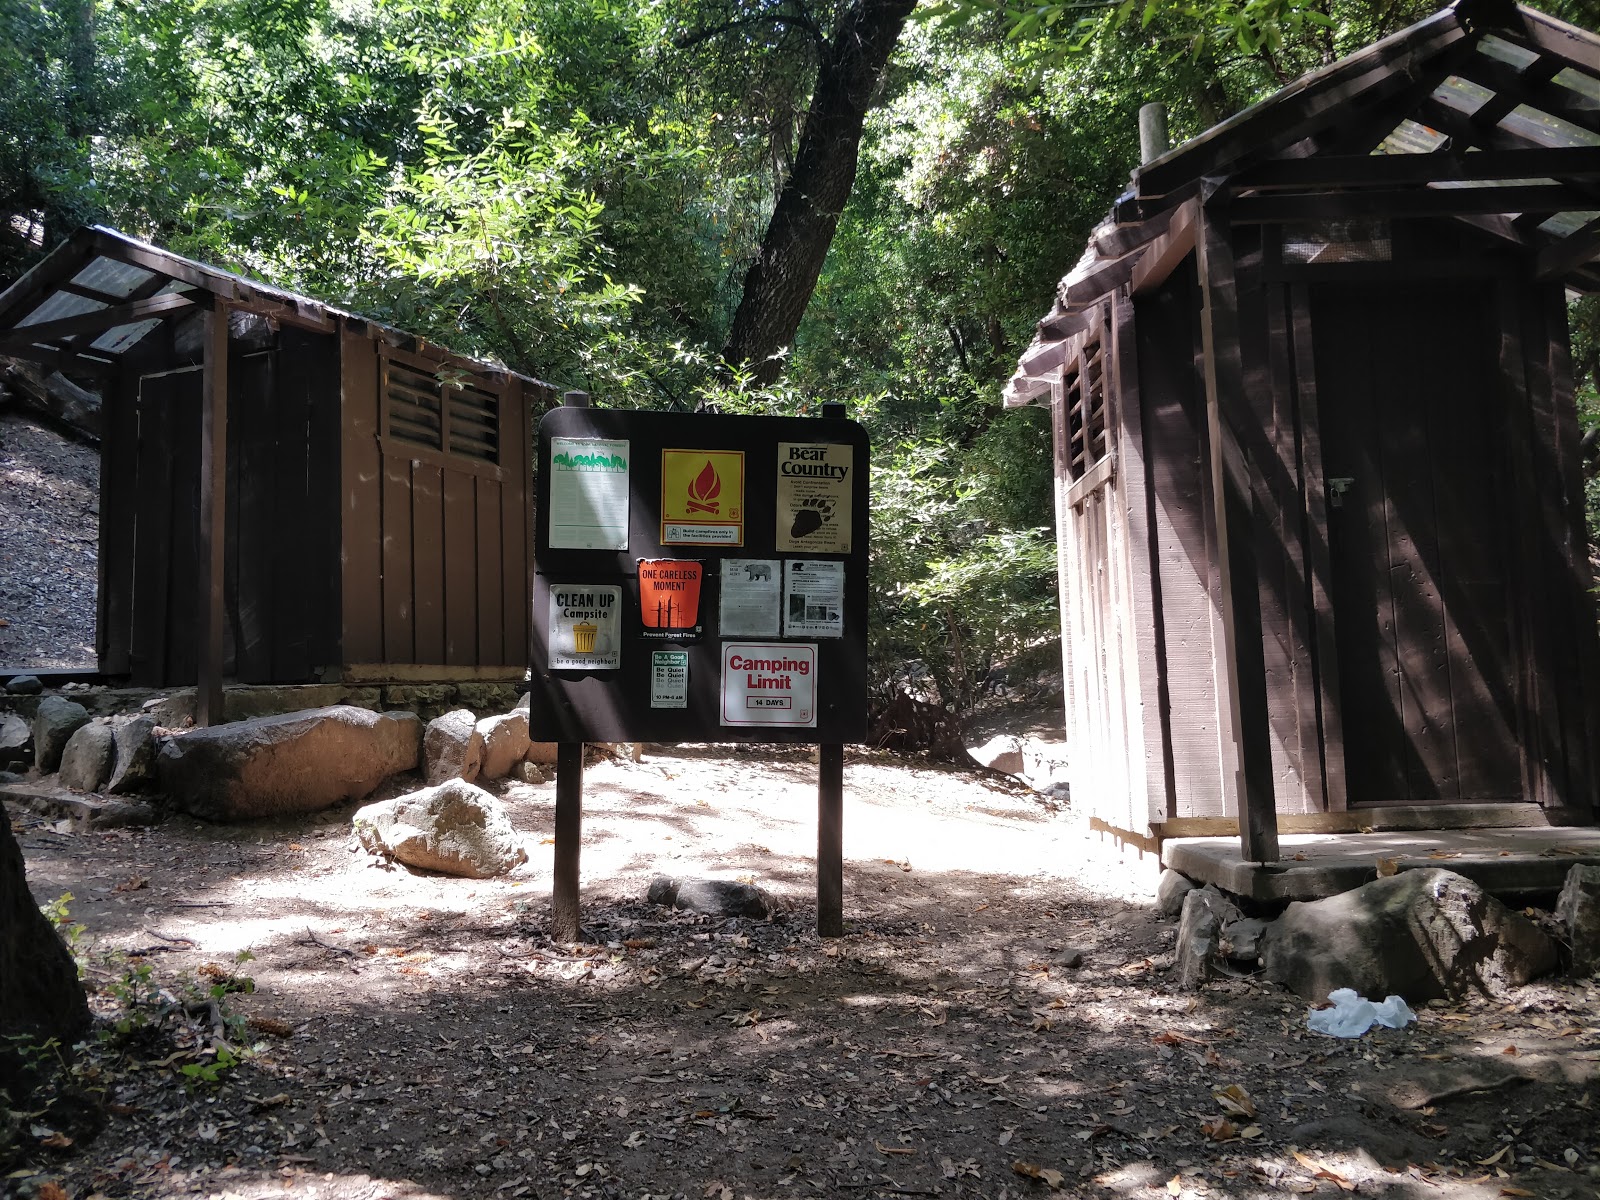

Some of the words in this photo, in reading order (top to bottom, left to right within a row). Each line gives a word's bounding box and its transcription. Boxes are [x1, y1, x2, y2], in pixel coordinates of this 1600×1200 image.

[789, 447, 827, 461] Bear
[781, 461, 849, 483] Country
[642, 570, 657, 579] ONE
[660, 570, 697, 580] CARELESS
[653, 582, 686, 591] MOMENT
[556, 593, 594, 607] CLEAN
[600, 594, 615, 607] UP
[563, 608, 608, 620] Campsite
[730, 655, 810, 675] Camping
[747, 674, 792, 690] Limit
